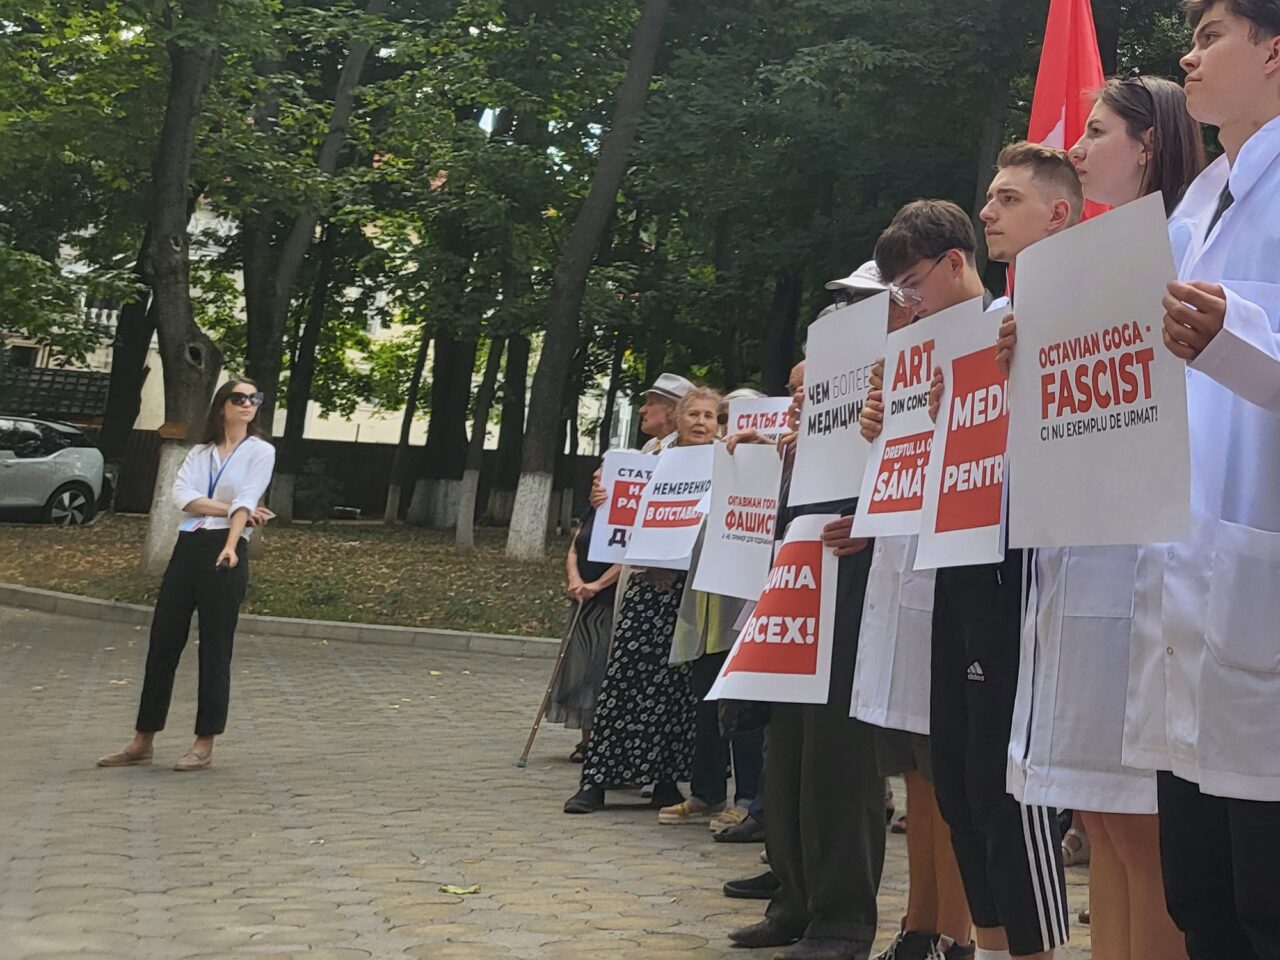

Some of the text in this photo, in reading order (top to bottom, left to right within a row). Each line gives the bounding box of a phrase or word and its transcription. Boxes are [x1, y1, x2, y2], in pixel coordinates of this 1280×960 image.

[1039, 332, 1100, 369] OCTAVIAN
[1102, 321, 1144, 352] GOGA
[808, 380, 830, 406] ЧЕМ
[1041, 347, 1155, 420] FASCIST
[891, 396, 905, 416] DIN
[952, 379, 1010, 431] MEDI
[737, 412, 778, 430] СТАТЬЯ
[1040, 405, 1158, 441] CI NU EXEMPLU DE URMAT!
[884, 442, 915, 460] DREPTUL
[916, 440, 927, 454] LA
[618, 468, 653, 480] СТАТ
[653, 480, 711, 496] НЕМЕРЕНКО
[646, 507, 655, 521] В
